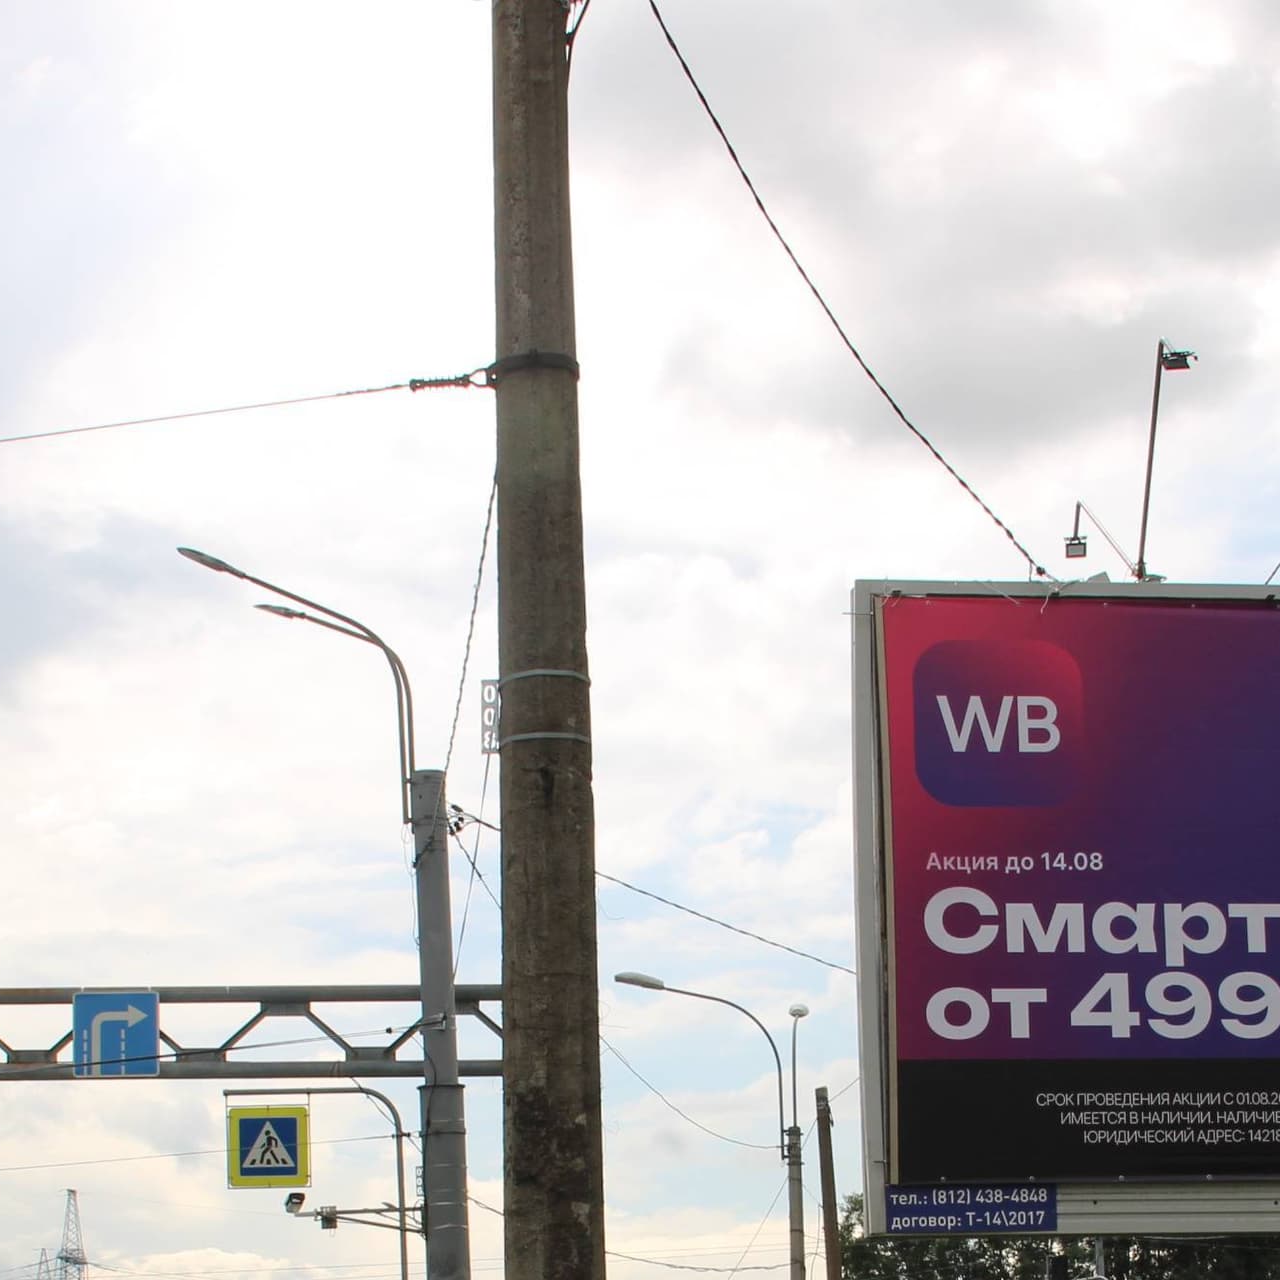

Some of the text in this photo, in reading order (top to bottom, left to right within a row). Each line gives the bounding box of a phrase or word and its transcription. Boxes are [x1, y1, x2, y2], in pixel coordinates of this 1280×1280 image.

[936, 695, 1061, 753] WB
[926, 852, 1103, 874] Акция до 14.08
[925, 986, 1048, 1040] от
[1036, 1093, 1074, 1106] СРОК
[1077, 1092, 1170, 1107] ПРОВЕДЕНИЯ
[1172, 1092, 1220, 1107] АКЦИИ
[1223, 1092, 1234, 1105] С
[1060, 1112, 1127, 1125] ИМЕЕТСЯ
[1130, 1112, 1139, 1124] В
[1141, 1111, 1214, 1125] НАЛИЧИИ.
[1084, 1128, 1194, 1145] ЮРИДИЧЕСКИЙ
[1197, 1129, 1245, 1145] АДРЕС:
[890, 1188, 1047, 1205] тел.: (812) 438-4848
[891, 1214, 961, 1230] договор:
